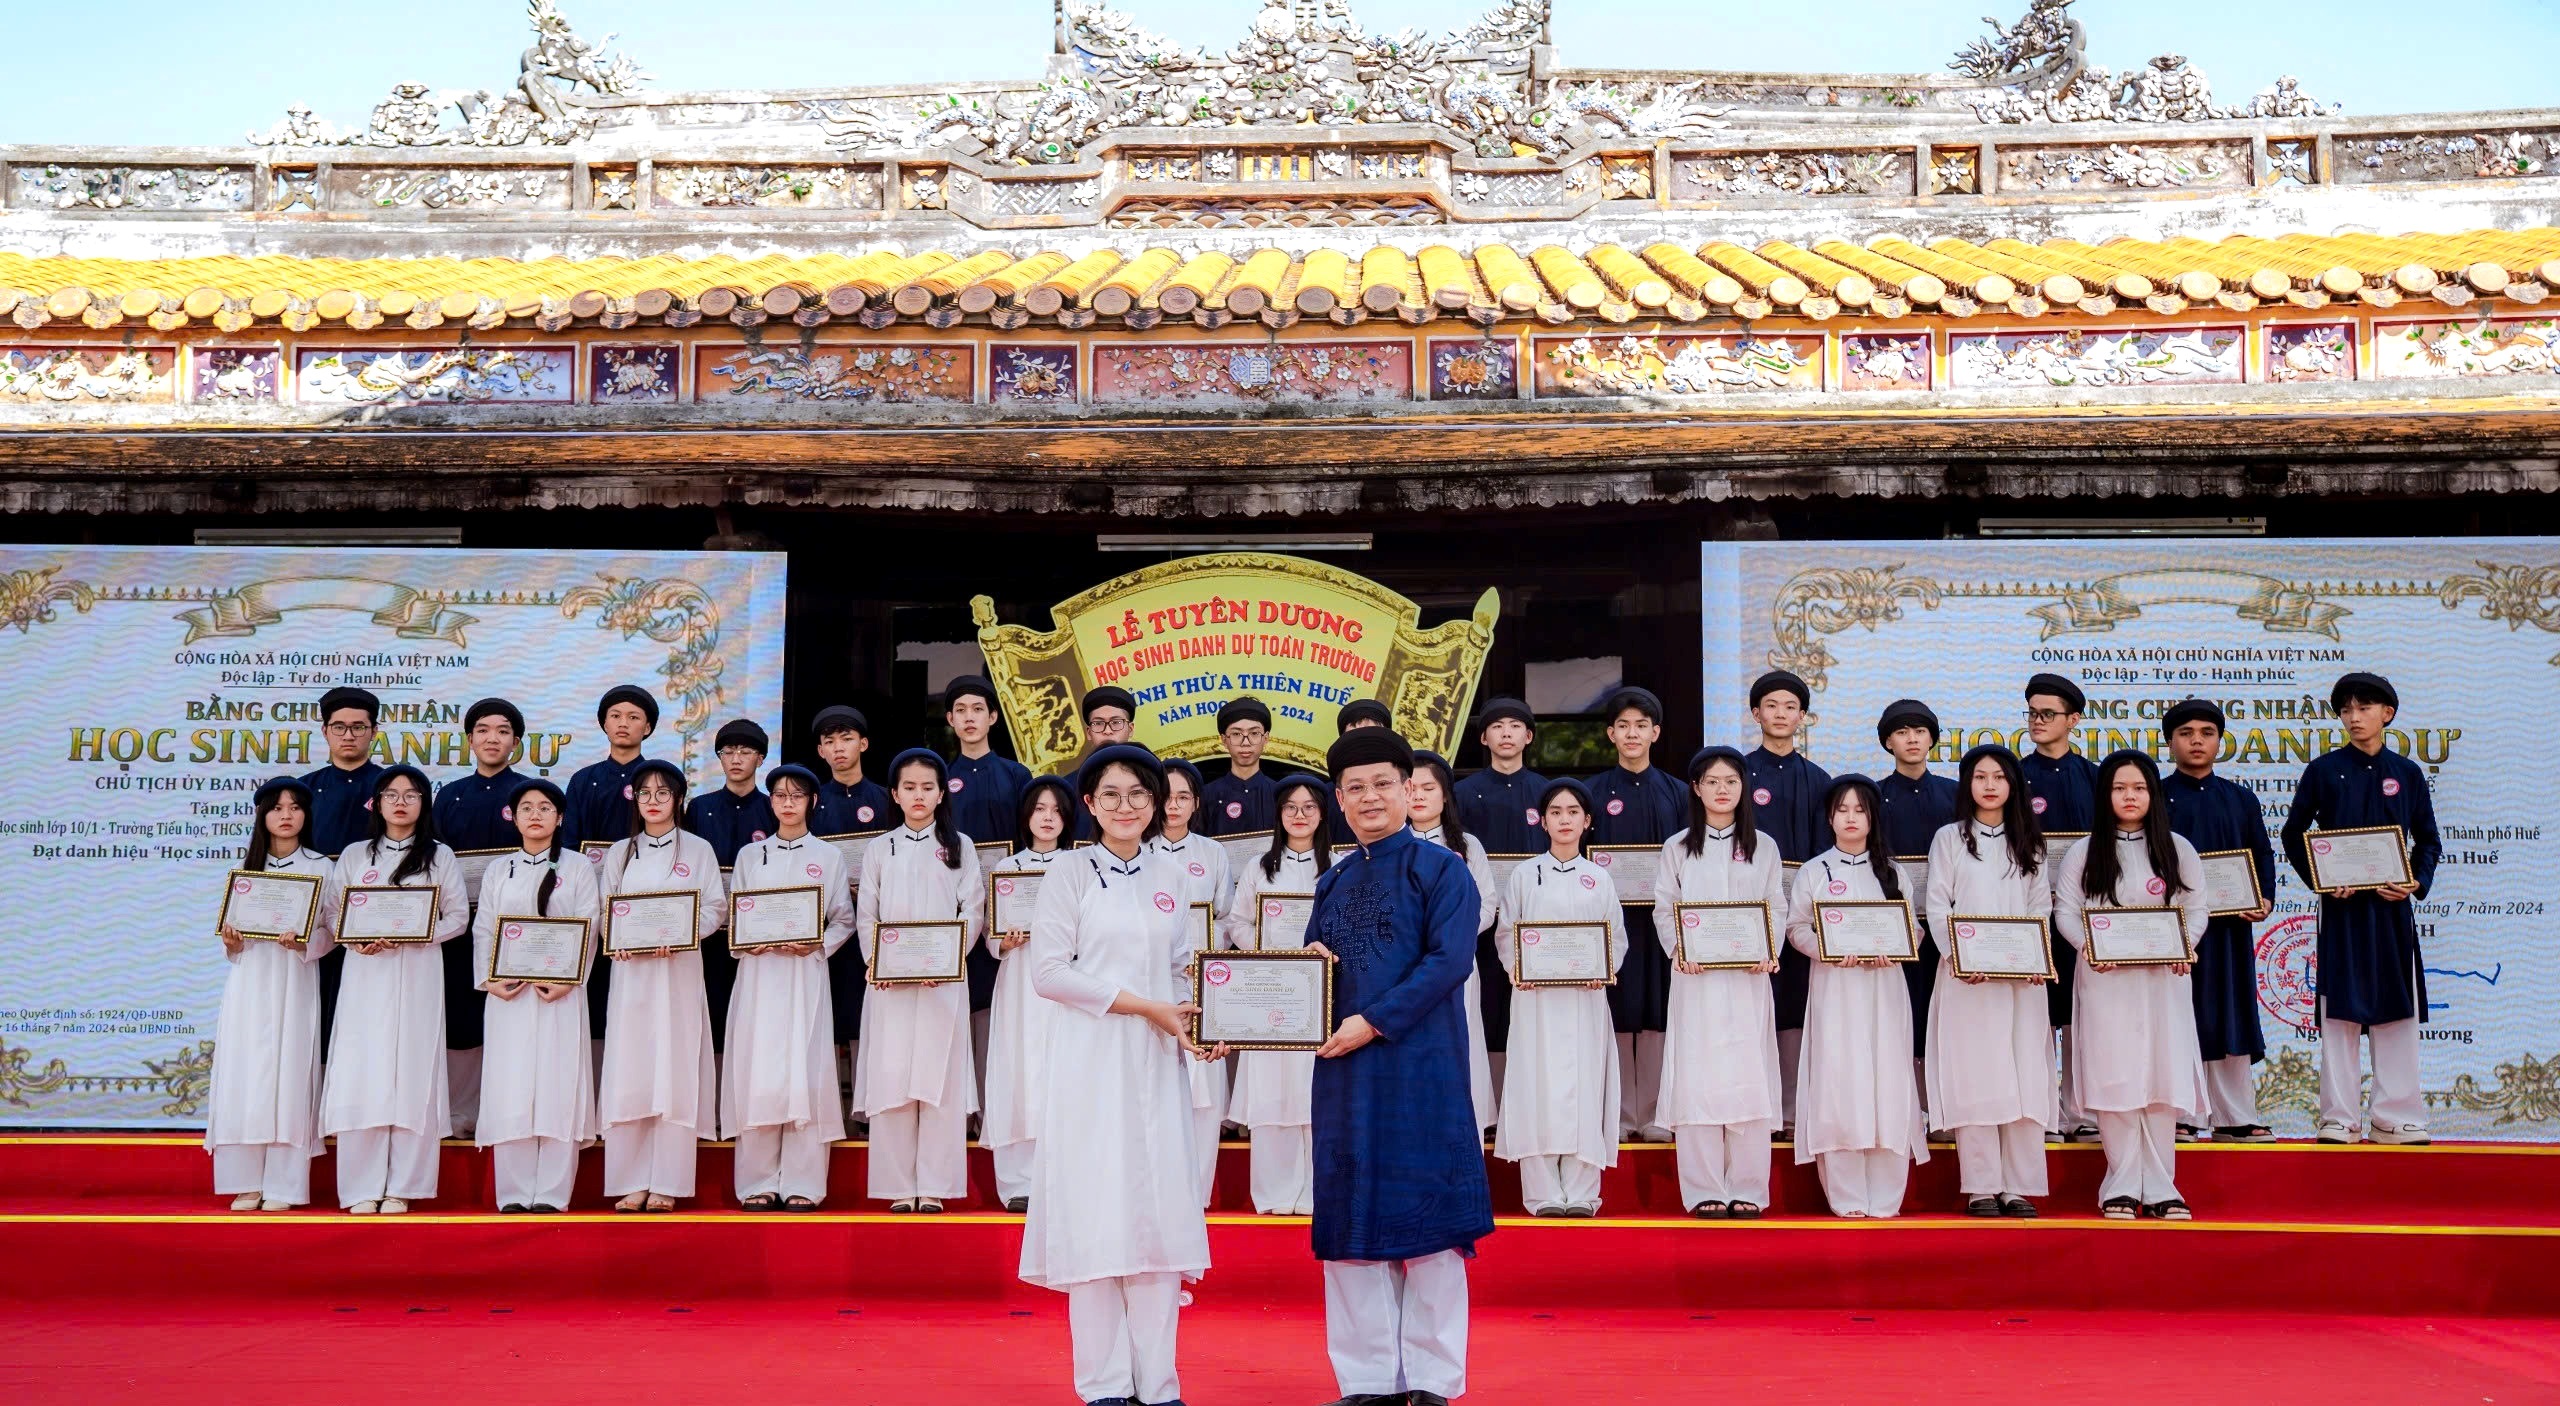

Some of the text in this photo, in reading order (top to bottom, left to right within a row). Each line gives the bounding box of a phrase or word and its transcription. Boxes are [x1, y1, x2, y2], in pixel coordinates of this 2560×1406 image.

[1106, 596, 1363, 648] LỄ TUYÊN DƯƠNG
[175, 650, 469, 669] CỘNG HÒA XÃ HỘI CHỦ NGHĨA VIỆT NAM
[1093, 634, 1377, 686] HỌC SINH DANH DỰ TOÀN TRƯỜNG
[2031, 647, 2345, 664] CỘNG HÒA XÃ HỘI CHỦ NGHĨA VIỆT NAM
[222, 671, 249, 685] Độc
[252, 671, 275, 685] lập
[289, 671, 309, 686] Tự
[312, 672, 330, 683] do
[343, 672, 381, 686] Hạnh
[386, 672, 422, 687] phúc
[2081, 668, 2110, 682] Độc
[2115, 668, 2138, 682] lập
[2152, 668, 2175, 682] Tự
[2179, 668, 2197, 680] do
[2212, 668, 2252, 682] Hạnh
[2257, 667, 2295, 682] phúc
[1172, 672, 1233, 696] THỪA
[1238, 672, 1302, 694] THIÊN
[1308, 682, 1355, 707] HUẾ
[186, 693, 264, 721] BẰNG
[380, 699, 462, 728] NHẬN
[1158, 705, 1192, 726] NĂM
[1280, 705, 1314, 724] 2024
[67, 727, 176, 771] HỌC
[189, 728, 313, 765] SINH
[327, 730, 471, 766] ANH
[2381, 727, 2462, 773] DỰ
[95, 773, 131, 790] CHỦ
[136, 777, 176, 793] TỊCH
[182, 774, 205, 791] ỦY
[210, 778, 246, 791] BAN
[190, 801, 230, 818] Tặng
[19, 821, 44, 834] sinh
[47, 820, 67, 837] lớp
[70, 821, 97, 837] 10/1
[109, 821, 154, 838] Trường
[156, 821, 182, 835] Tiểu
[185, 822, 208, 838] học,
[212, 823, 243, 836] THCS
[2443, 825, 2541, 843] Thành phố Huế
[33, 844, 62, 860] Đạt
[66, 845, 107, 858] danh
[112, 845, 148, 860] hiệu
[196, 846, 231, 859] sinh
[2463, 850, 2500, 864] Huế
[2413, 901, 2545, 917] háng 7 năm 2024
[20, 1008, 50, 1020] Quyết
[53, 1009, 77, 1019] định
[80, 1009, 95, 1018] số:
[99, 1009, 183, 1021] 1924/QĐ-UBND
[5, 1022, 195, 1034] 16 tháng 7 năm 2024 của UBND tỉnh
